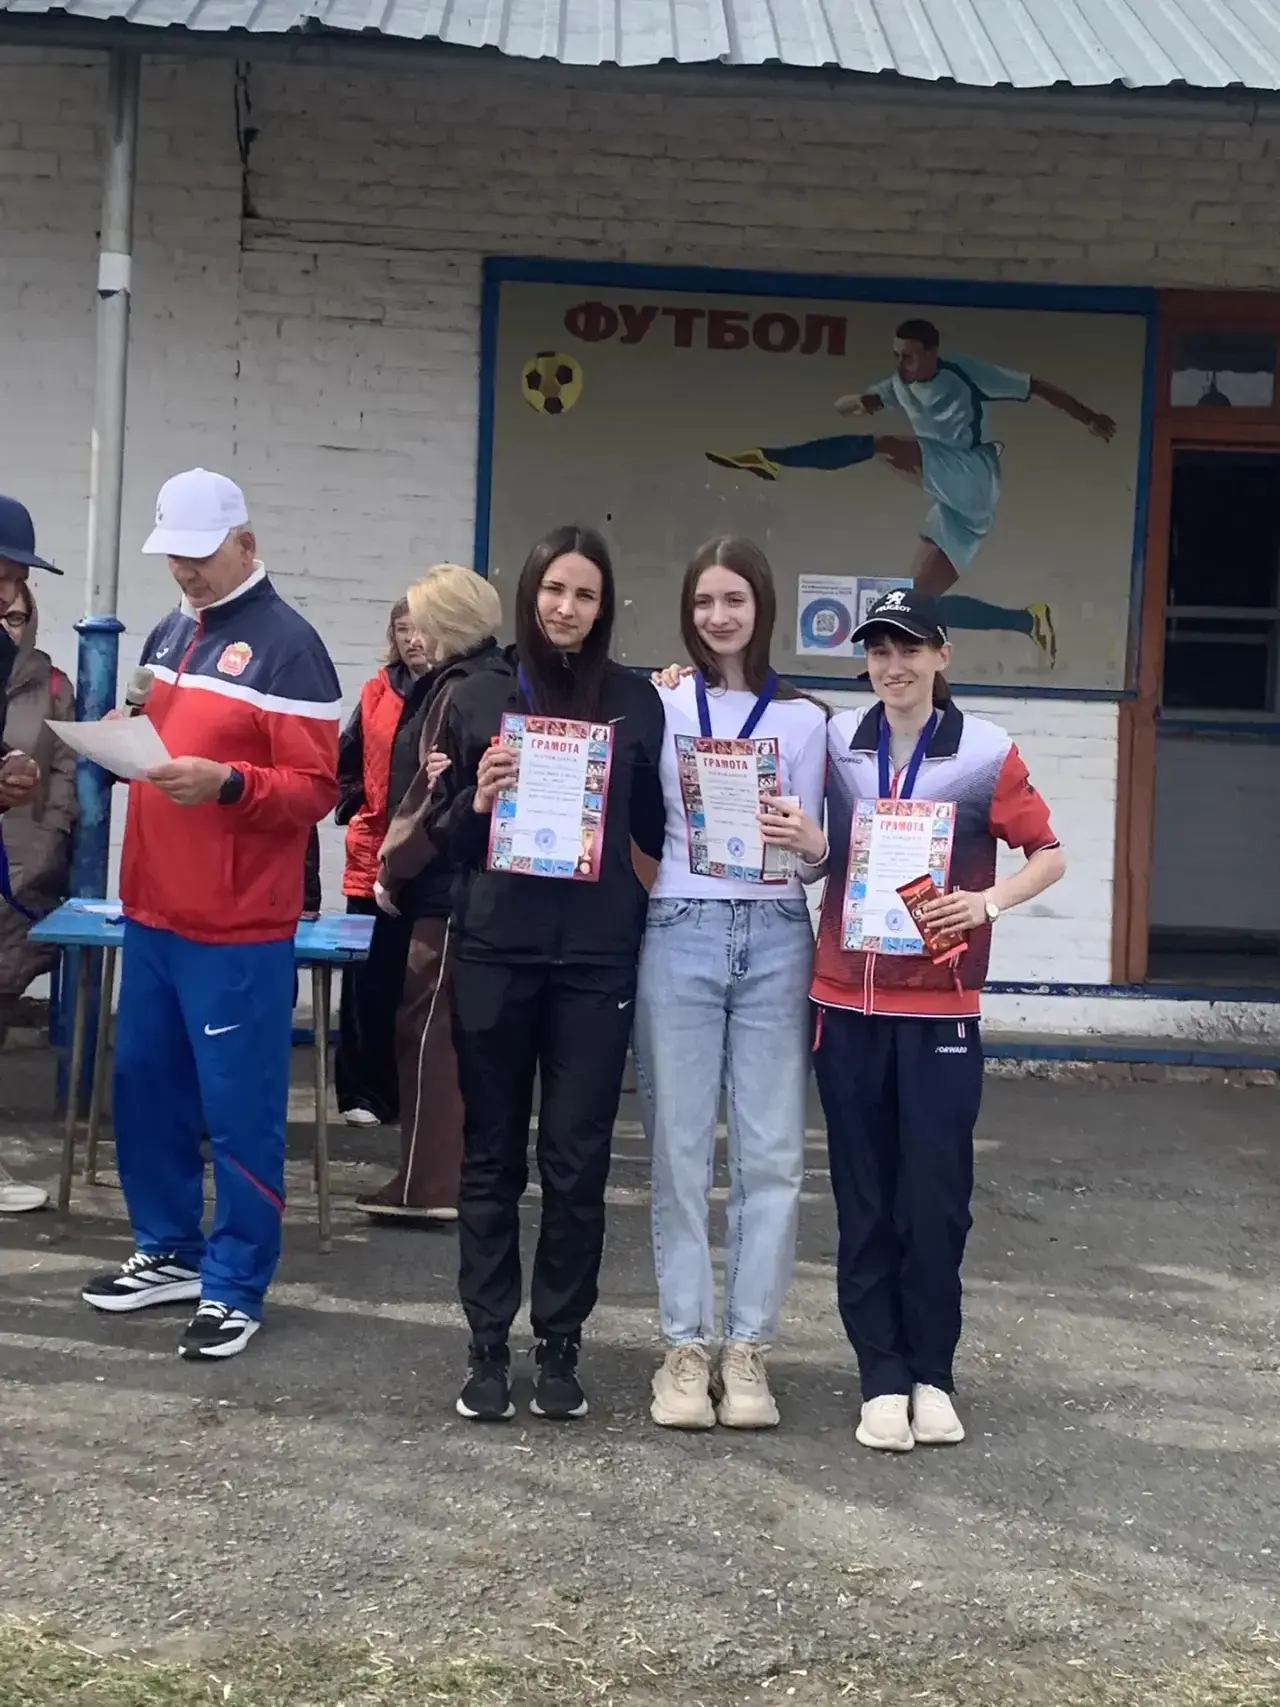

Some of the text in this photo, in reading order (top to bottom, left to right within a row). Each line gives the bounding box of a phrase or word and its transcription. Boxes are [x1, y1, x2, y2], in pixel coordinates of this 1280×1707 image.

[564, 301, 847, 356] ФУТБОЛ
[531, 739, 579, 754] ГРАМОТА
[703, 758, 748, 770] ГРАМОТА
[880, 820, 924, 833] ГРАМОТА
